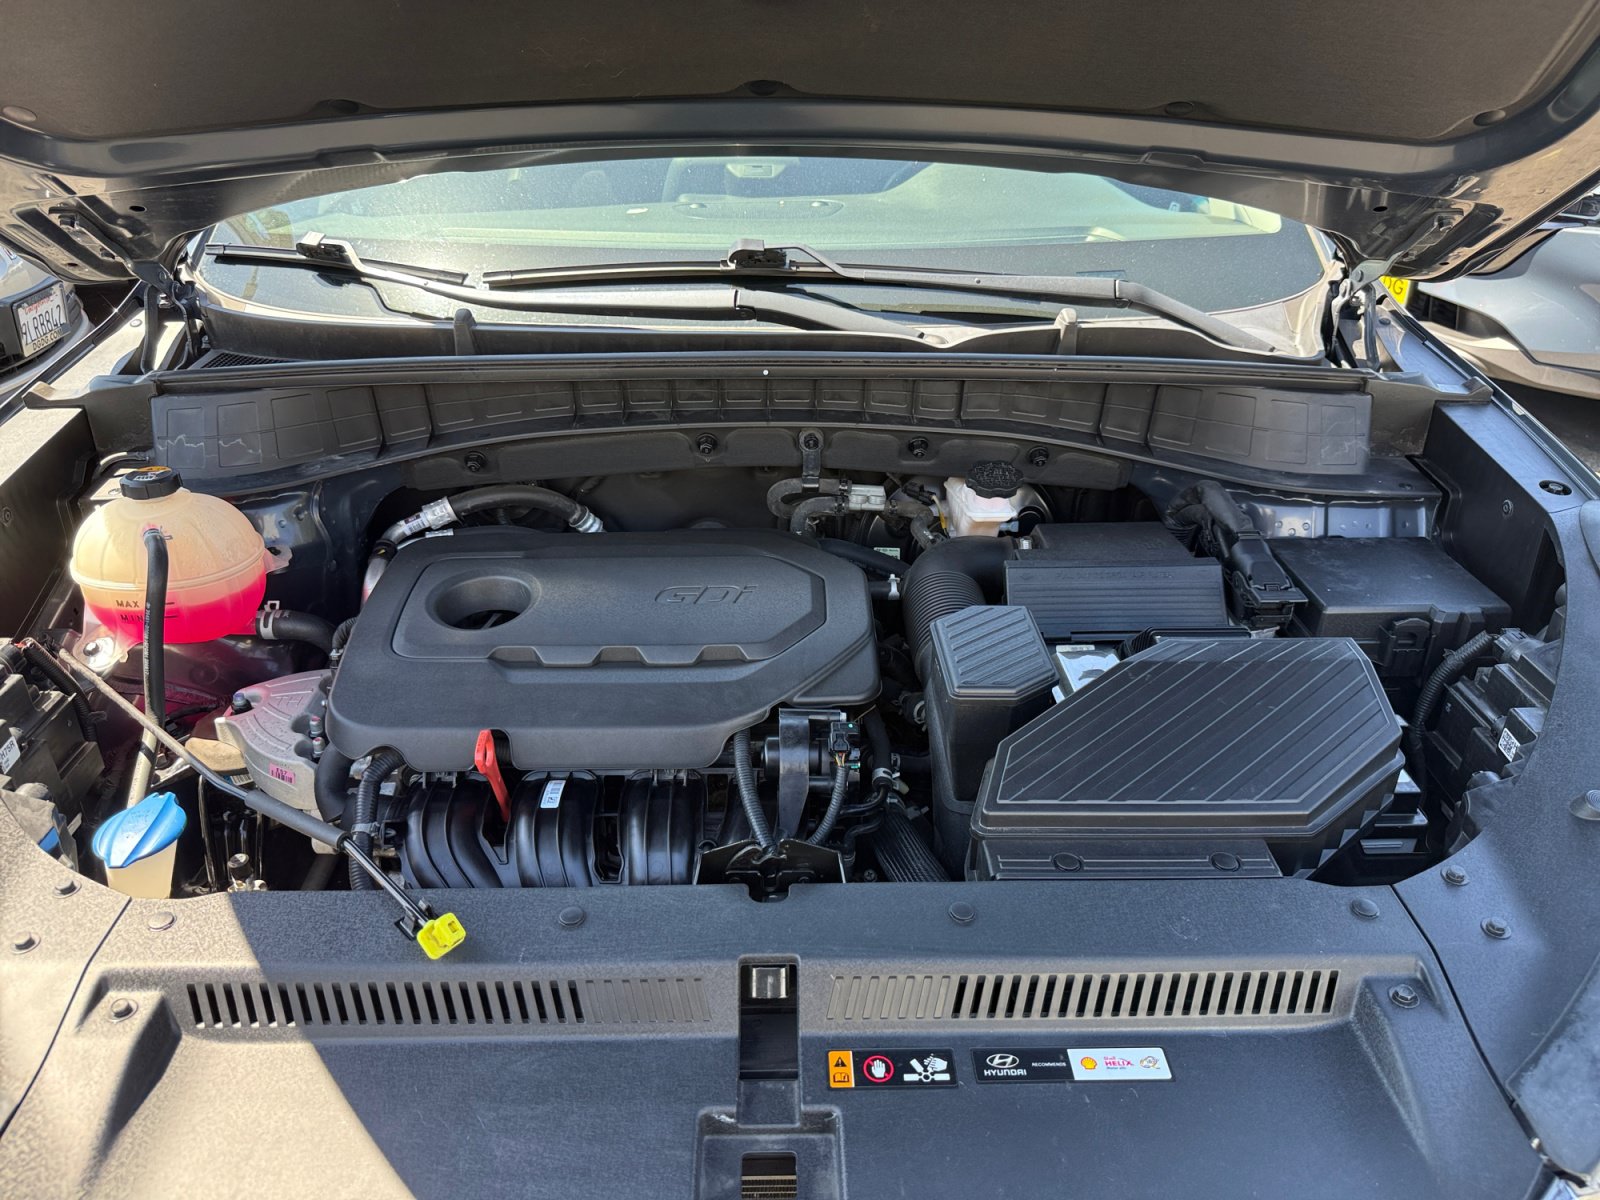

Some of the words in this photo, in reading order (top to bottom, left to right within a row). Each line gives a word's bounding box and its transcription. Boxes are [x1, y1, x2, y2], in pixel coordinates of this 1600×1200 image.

[115, 599, 139, 608] MAX
[120, 614, 144, 622] MIN
[983, 1068, 1027, 1076] HYUNDAI
